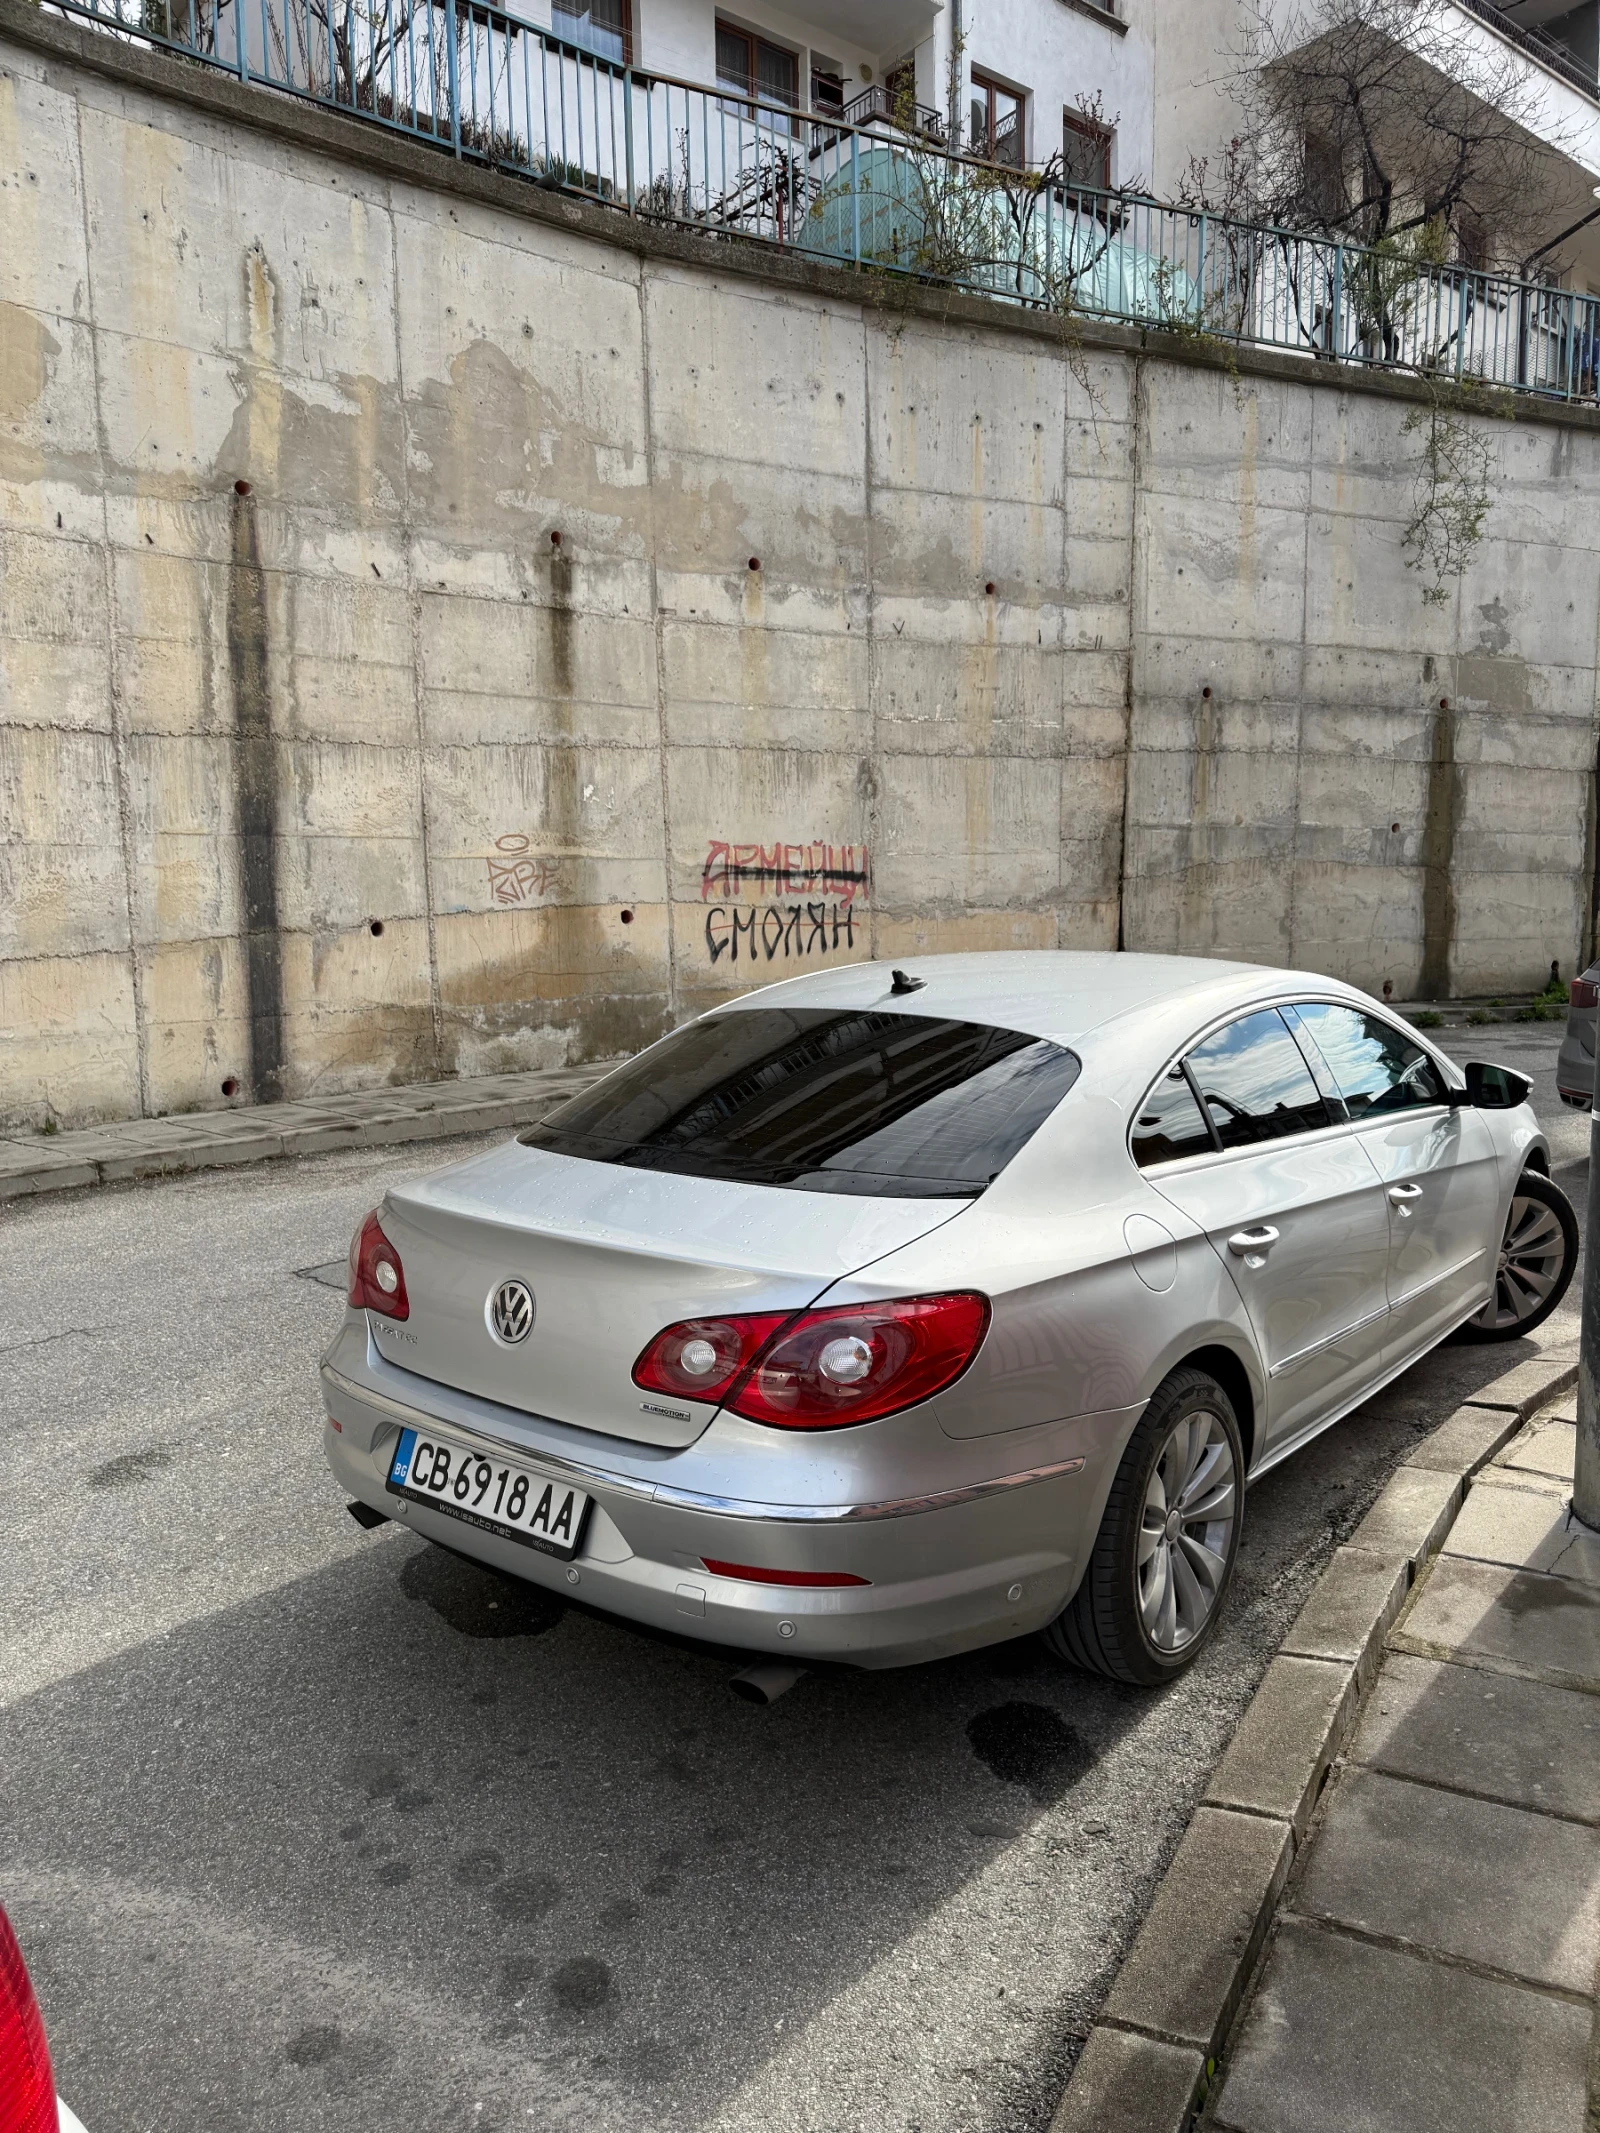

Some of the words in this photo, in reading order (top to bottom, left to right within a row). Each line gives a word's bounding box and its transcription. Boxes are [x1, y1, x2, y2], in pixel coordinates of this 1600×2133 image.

[705, 902, 854, 964] СМОЛЯН
[394, 1462, 408, 1478] BG
[439, 1503, 512, 1538] www.isauto.net
